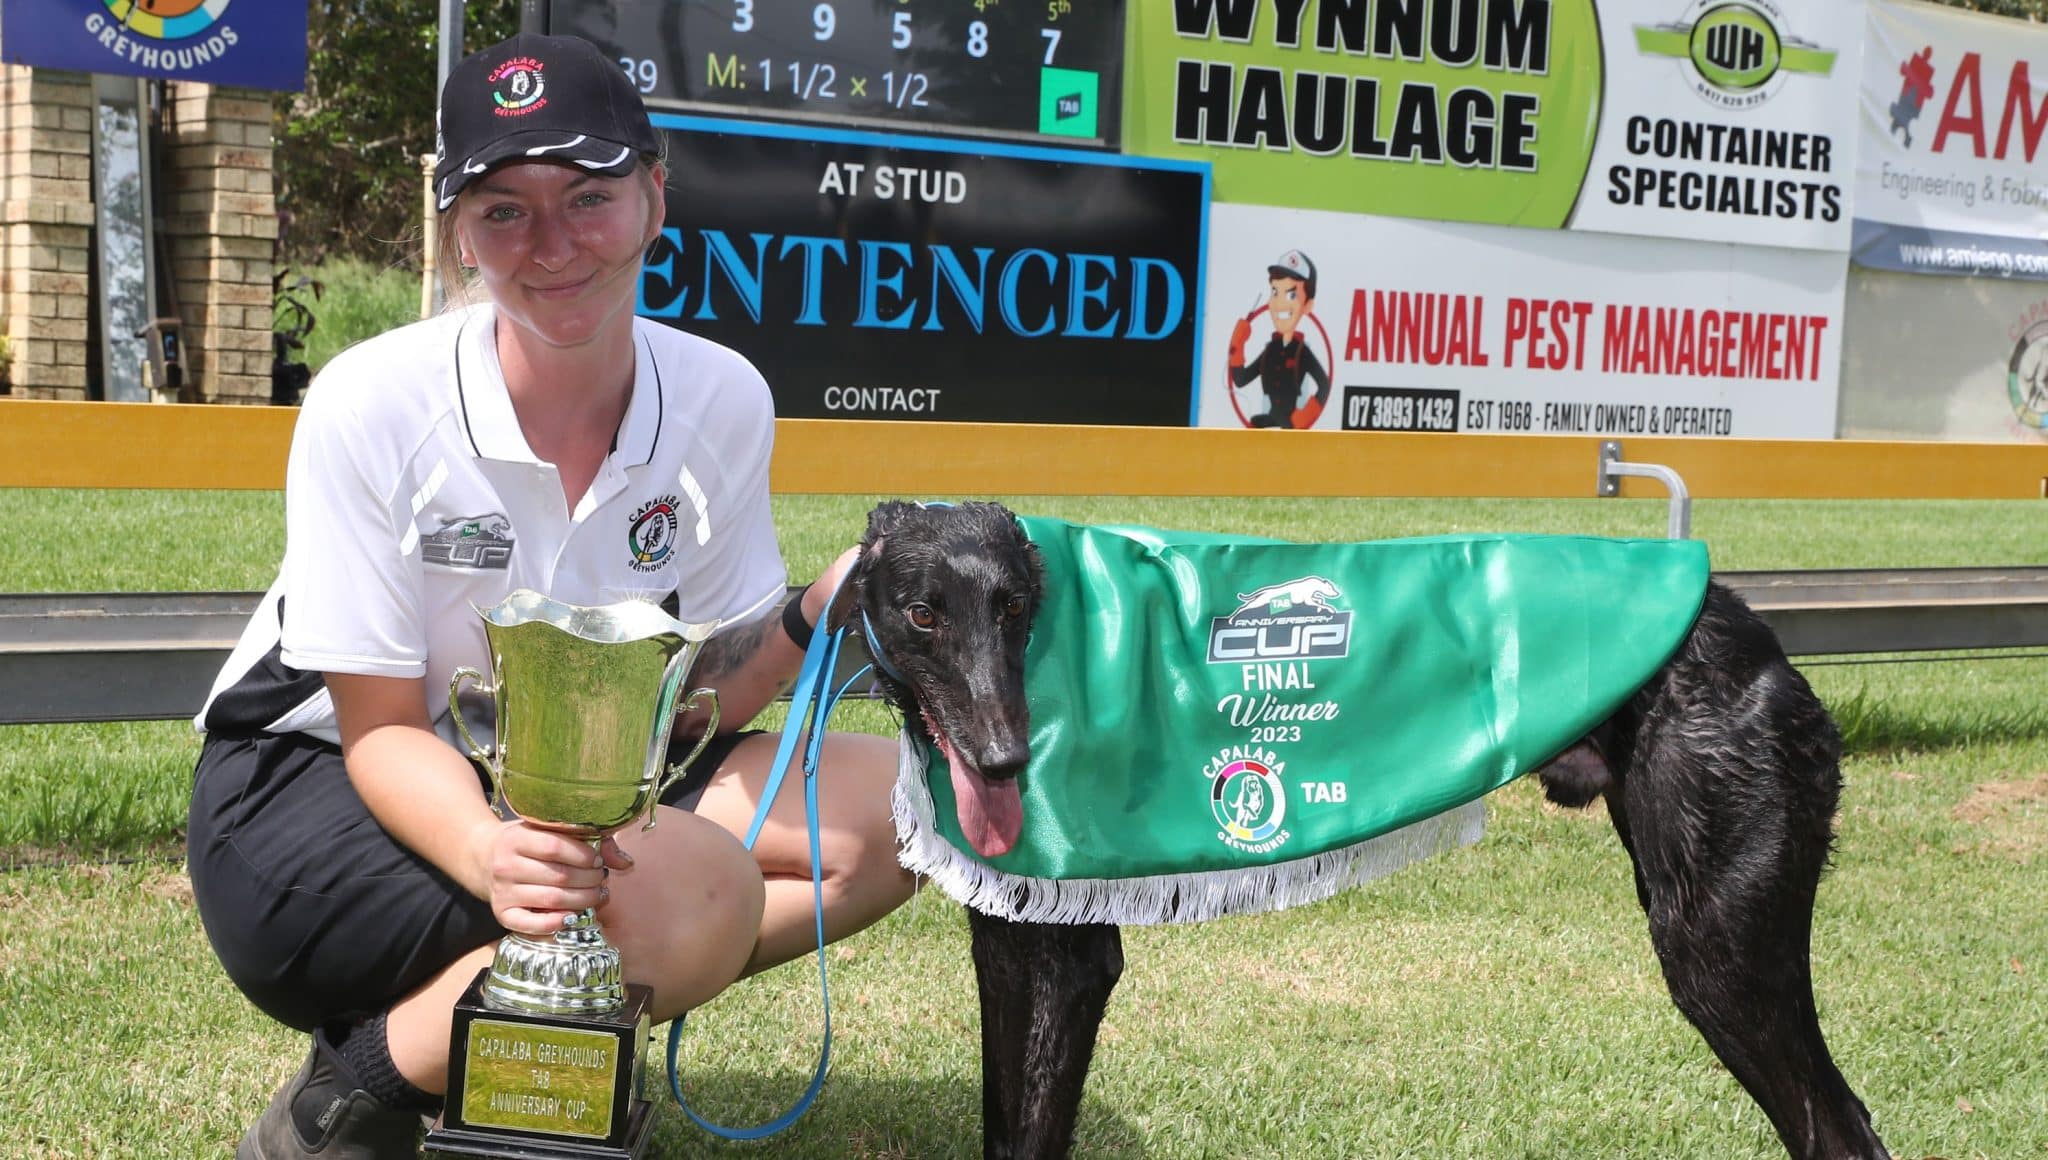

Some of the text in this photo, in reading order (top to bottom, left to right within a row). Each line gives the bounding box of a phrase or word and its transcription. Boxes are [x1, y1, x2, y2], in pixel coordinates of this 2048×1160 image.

[1047, 0, 1072, 21] 5th
[85, 13, 238, 70] GREYHOUNDS
[732, 0, 1062, 65] 3 9 5 8 7
[1706, 24, 1764, 70] WH
[488, 57, 544, 81] CAPALABA
[707, 52, 746, 89] M:
[759, 59, 771, 92] 1
[788, 62, 836, 100] 1/2
[882, 71, 929, 109] 1/2
[1059, 100, 1080, 114] TAB
[1173, 59, 1540, 172] HAULAGE
[1626, 115, 1832, 172] CONTAINER
[819, 162, 967, 204] AT STUD
[1608, 164, 1841, 222] SPECIALISTS
[1881, 161, 1975, 207] Engineering
[1982, 175, 1994, 201] &
[636, 227, 1185, 341] ENTENCED
[1344, 288, 1828, 381] ANNUAL PEST MANAGEMENT
[824, 386, 940, 412] CONTACT
[1349, 395, 1370, 427] 07
[1372, 396, 1413, 429] 3893
[1416, 397, 1455, 430] 1432
[1466, 400, 1494, 429] EST
[1498, 401, 1532, 431] 1968
[1544, 402, 1592, 432] FAMILY
[1595, 404, 1645, 433] OWNED
[1650, 405, 1660, 433] &
[1663, 406, 1732, 436] OPERATED
[629, 494, 680, 522] CAPALABA
[1271, 599, 1291, 608] TAB
[1234, 615, 1333, 627] ANNIVERSARY
[1213, 624, 1345, 658] CUP
[1242, 663, 1315, 690] FINAL
[1217, 692, 1340, 727] Winner
[1250, 726, 1301, 743] 2023
[1203, 745, 1285, 778] CAPALABA
[1301, 782, 1347, 803] TAB
[1217, 829, 1290, 854] GREYHOUNDS
[480, 1038, 606, 1069] CAPALABA GREYHOUNDS
[532, 1069, 549, 1089] TAB
[489, 1092, 586, 1120] ANNIVERSARY CUP
